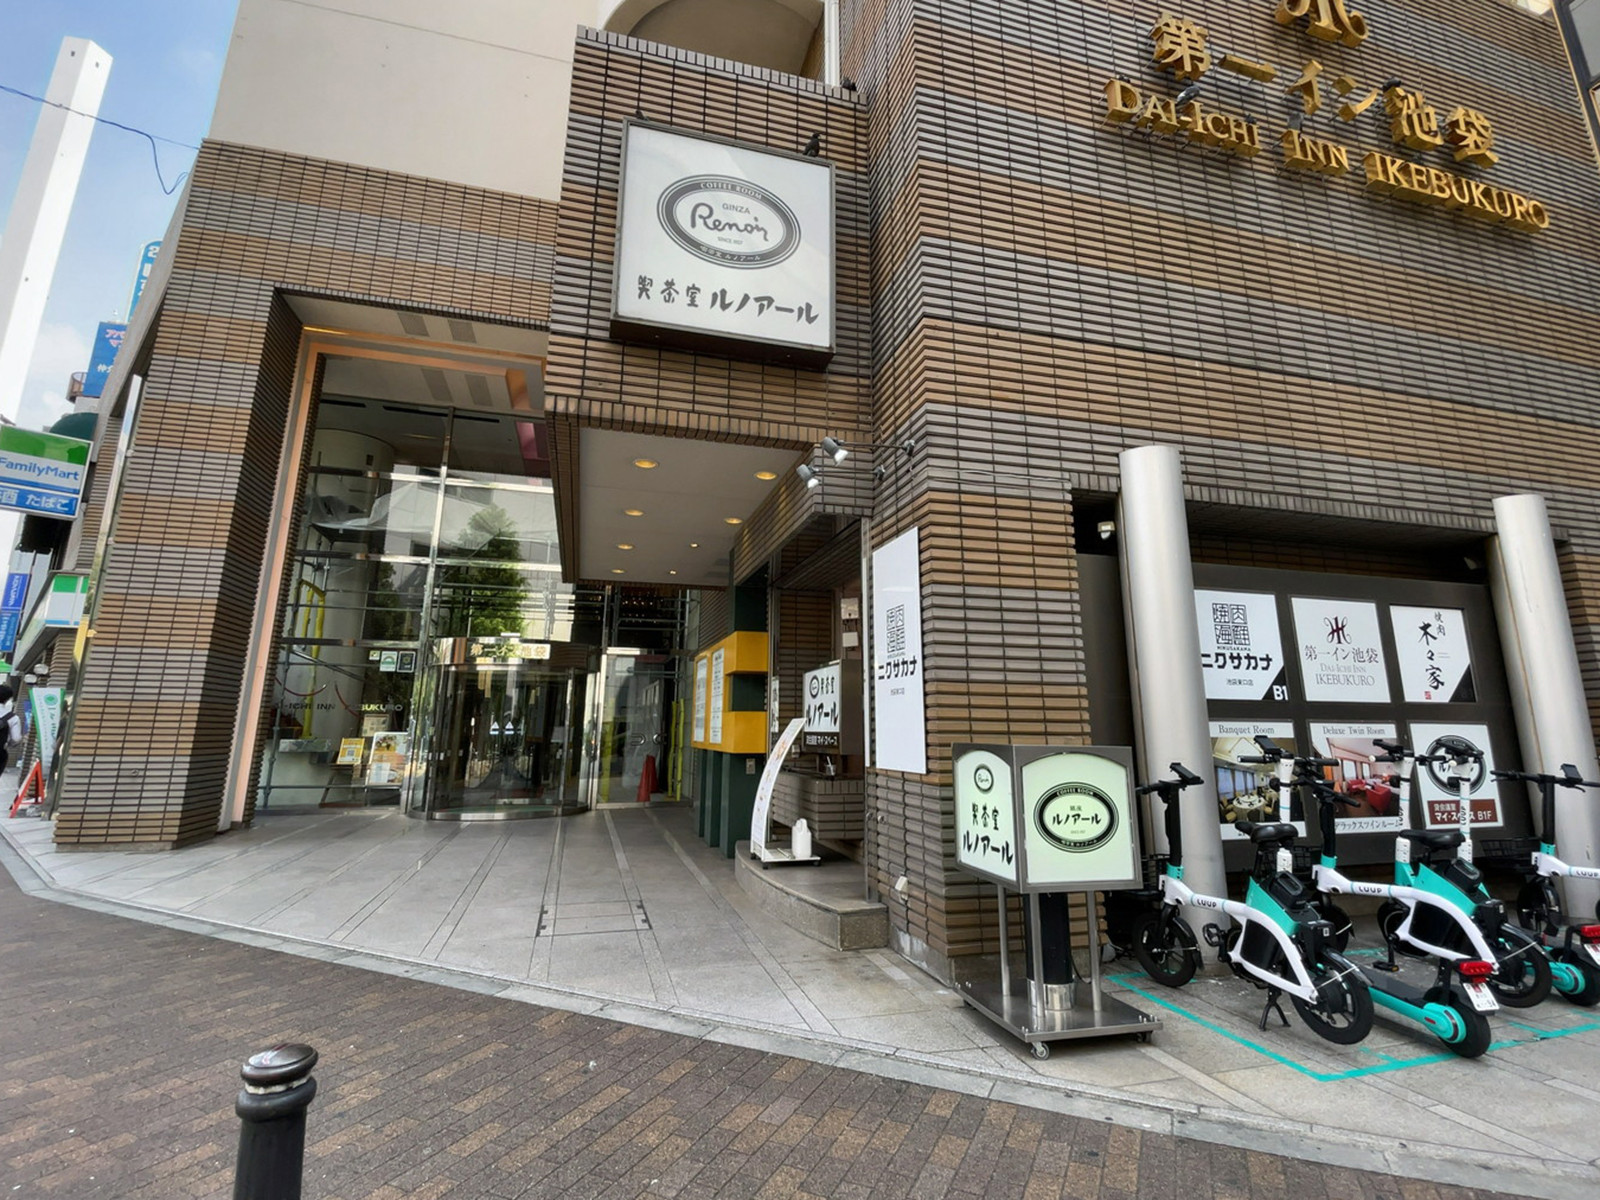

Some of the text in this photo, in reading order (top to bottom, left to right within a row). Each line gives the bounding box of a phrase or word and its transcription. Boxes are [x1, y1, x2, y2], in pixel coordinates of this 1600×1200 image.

[1150, 11, 1500, 170] 第一イン池袋
[1103, 78, 1550, 234] DAI-ICHI INN IKEBUKURO
[735, 186, 763, 200] ROOM
[722, 203, 751, 214] GINZA
[690, 202, 769, 242] Renoir
[637, 274, 820, 325] 喫茶室 ルノアール
[0, 456, 80, 481] FamilyMart
[25, 493, 70, 511] たばこ
[1201, 652, 1273, 671] ニクサカナ
[1304, 644, 1379, 664] 第一イン池袋
[1417, 620, 1445, 691] 木々家
[878, 656, 917, 680] ニクサカナ
[1315, 673, 1376, 687] IKEBUKURO
[1273, 684, 1288, 701] B1
[805, 701, 839, 727] ルノアール
[1218, 724, 1275, 736] Banquet Room
[1322, 726, 1386, 735] Deluxe Twin Room
[971, 803, 1000, 831] 喫茶室
[1052, 812, 1102, 826] ルノアール
[1434, 810, 1492, 822] マイ・スス B1F
[962, 830, 1014, 866] ルノアール
[1358, 885, 1382, 894] LUUP
[1197, 898, 1217, 908] LUUP
